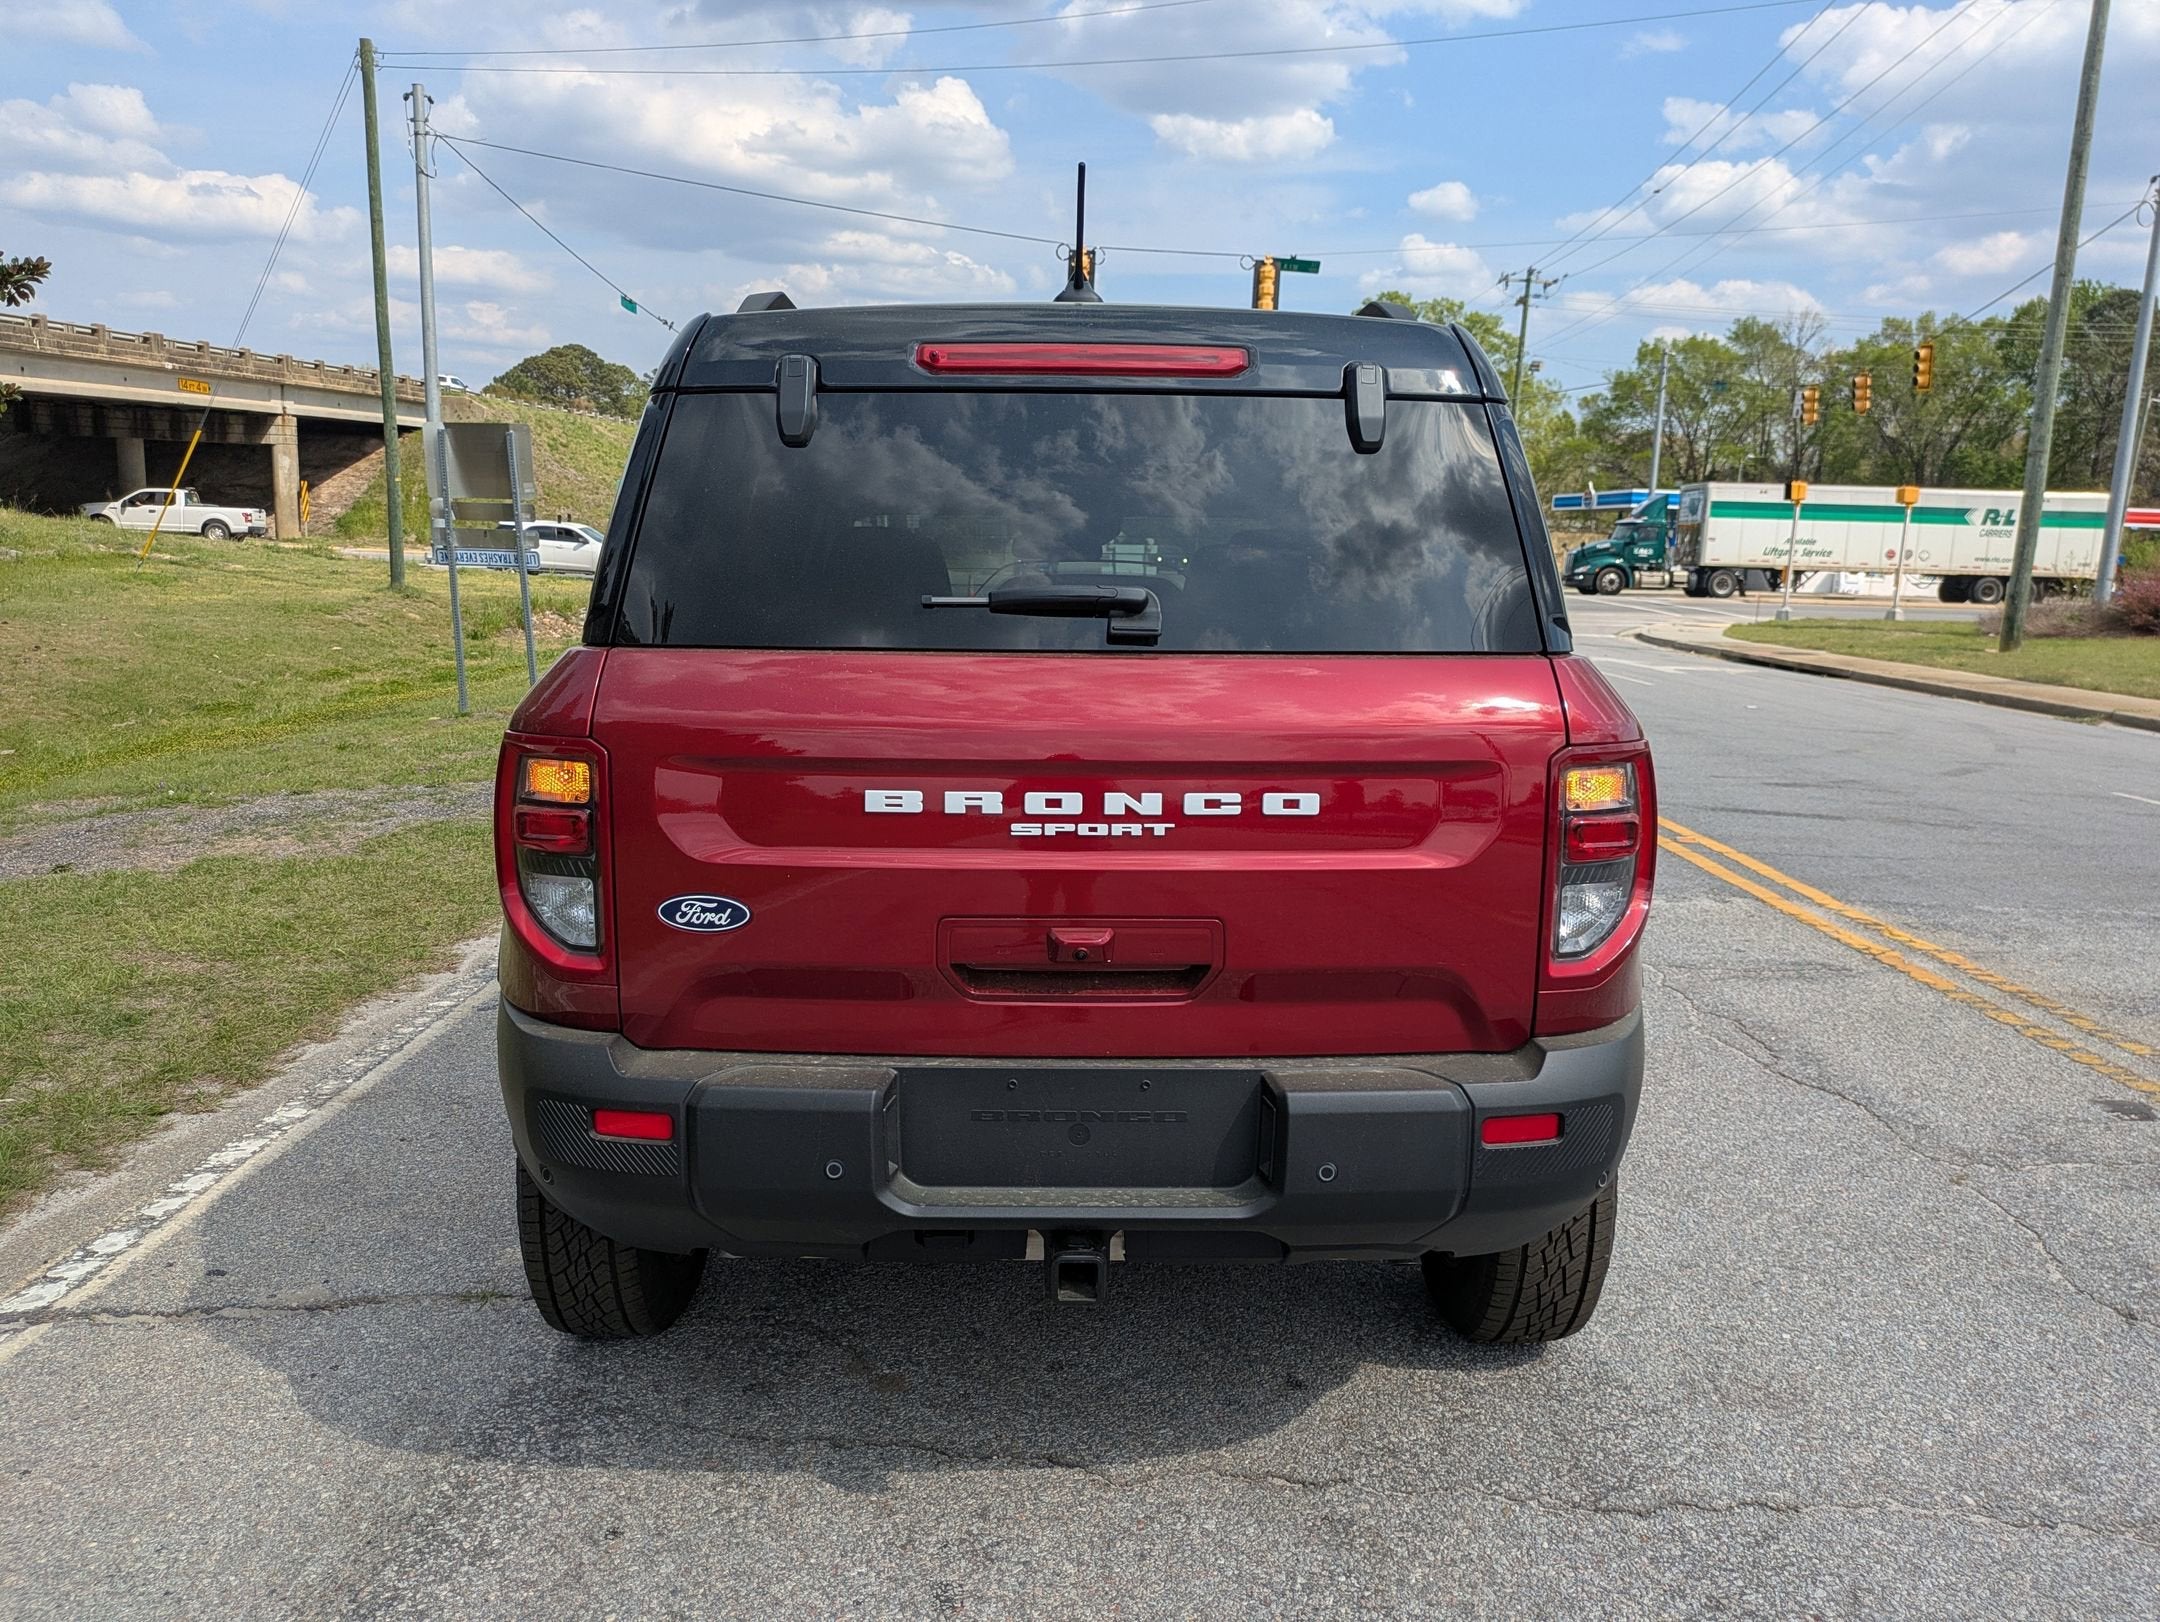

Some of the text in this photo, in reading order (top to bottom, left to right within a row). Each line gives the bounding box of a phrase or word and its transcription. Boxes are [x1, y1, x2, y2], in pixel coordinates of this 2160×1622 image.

[1979, 529, 2013, 538] CARRIERS
[440, 551, 537, 566] LITR TRASHES EVERYNE
[1800, 547, 1833, 558] Service
[864, 789, 1321, 816] BRONCO
[1010, 823, 1175, 837] SPORT
[675, 900, 732, 926] Ford
[970, 1109, 1188, 1123] BRONCO
